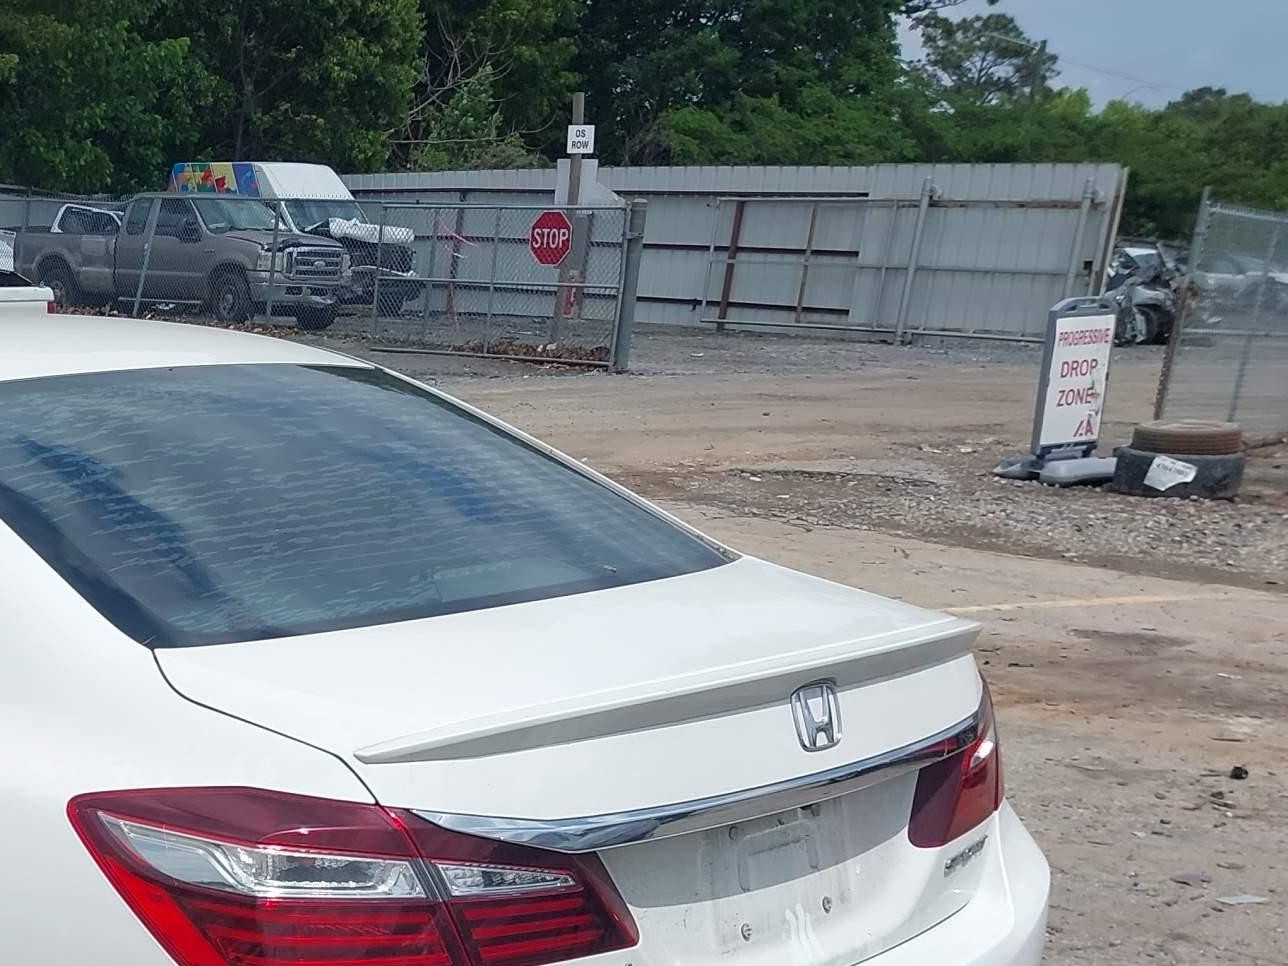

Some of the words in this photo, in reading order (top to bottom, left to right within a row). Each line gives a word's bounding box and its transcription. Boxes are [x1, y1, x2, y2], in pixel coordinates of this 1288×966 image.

[572, 140, 590, 149] ROW
[532, 228, 569, 248] STOP
[1058, 328, 1111, 346] PROGRESSIVE
[1060, 359, 1098, 378] DROP
[1056, 387, 1094, 407] ZONE
